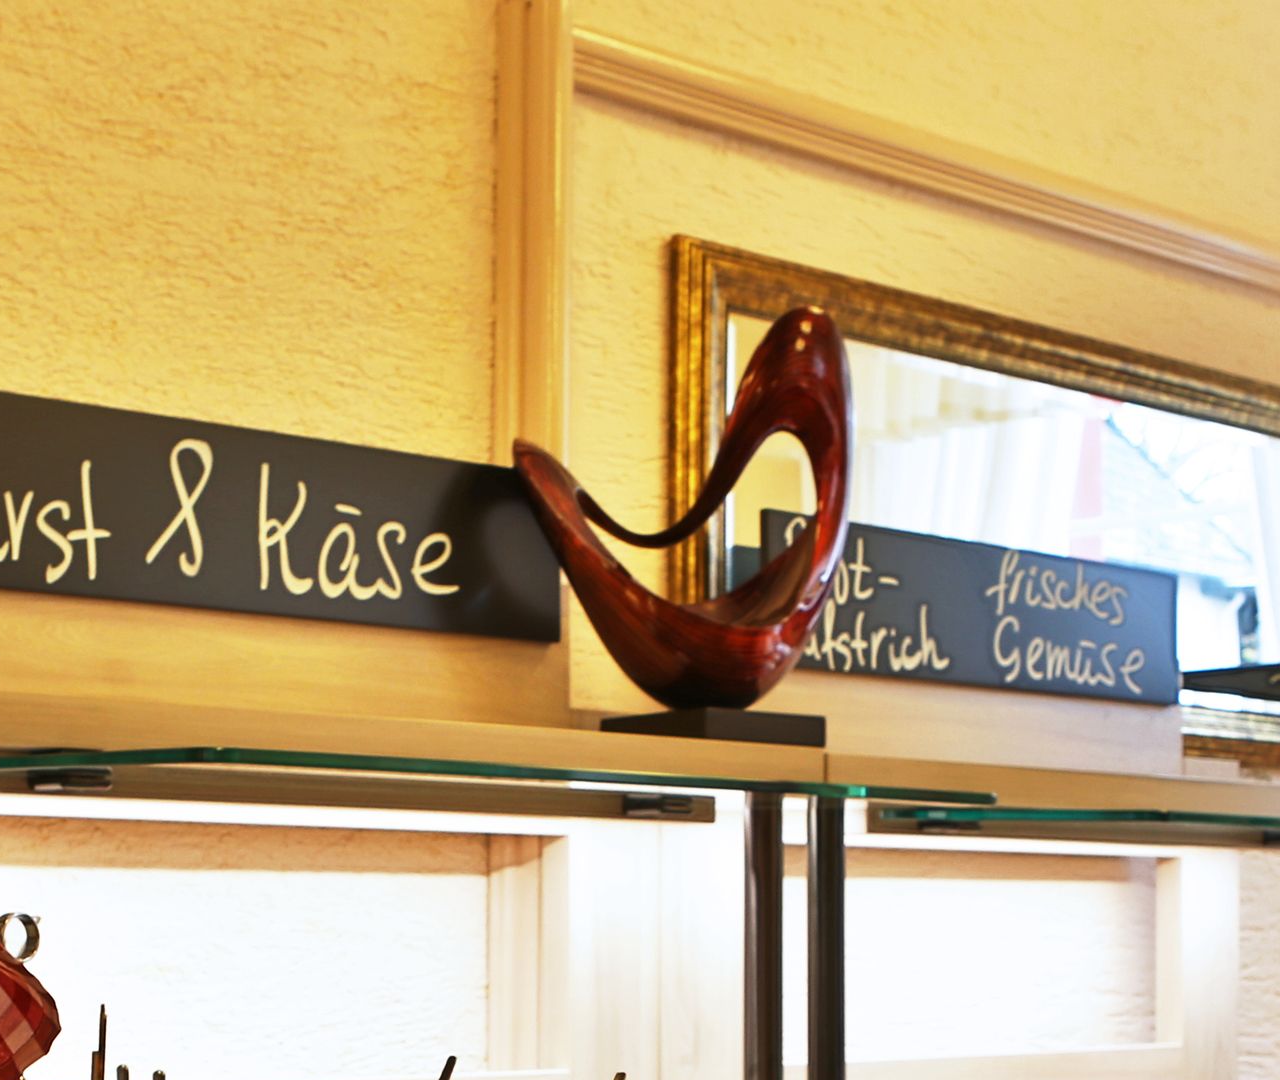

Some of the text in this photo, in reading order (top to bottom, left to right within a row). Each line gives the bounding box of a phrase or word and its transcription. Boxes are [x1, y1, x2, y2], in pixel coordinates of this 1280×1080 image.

[145, 438, 214, 577] &
[258, 462, 460, 600] Käse
[987, 549, 1129, 626] frisches
[804, 598, 950, 672] ufstrich
[994, 615, 1146, 694] Gemüse
